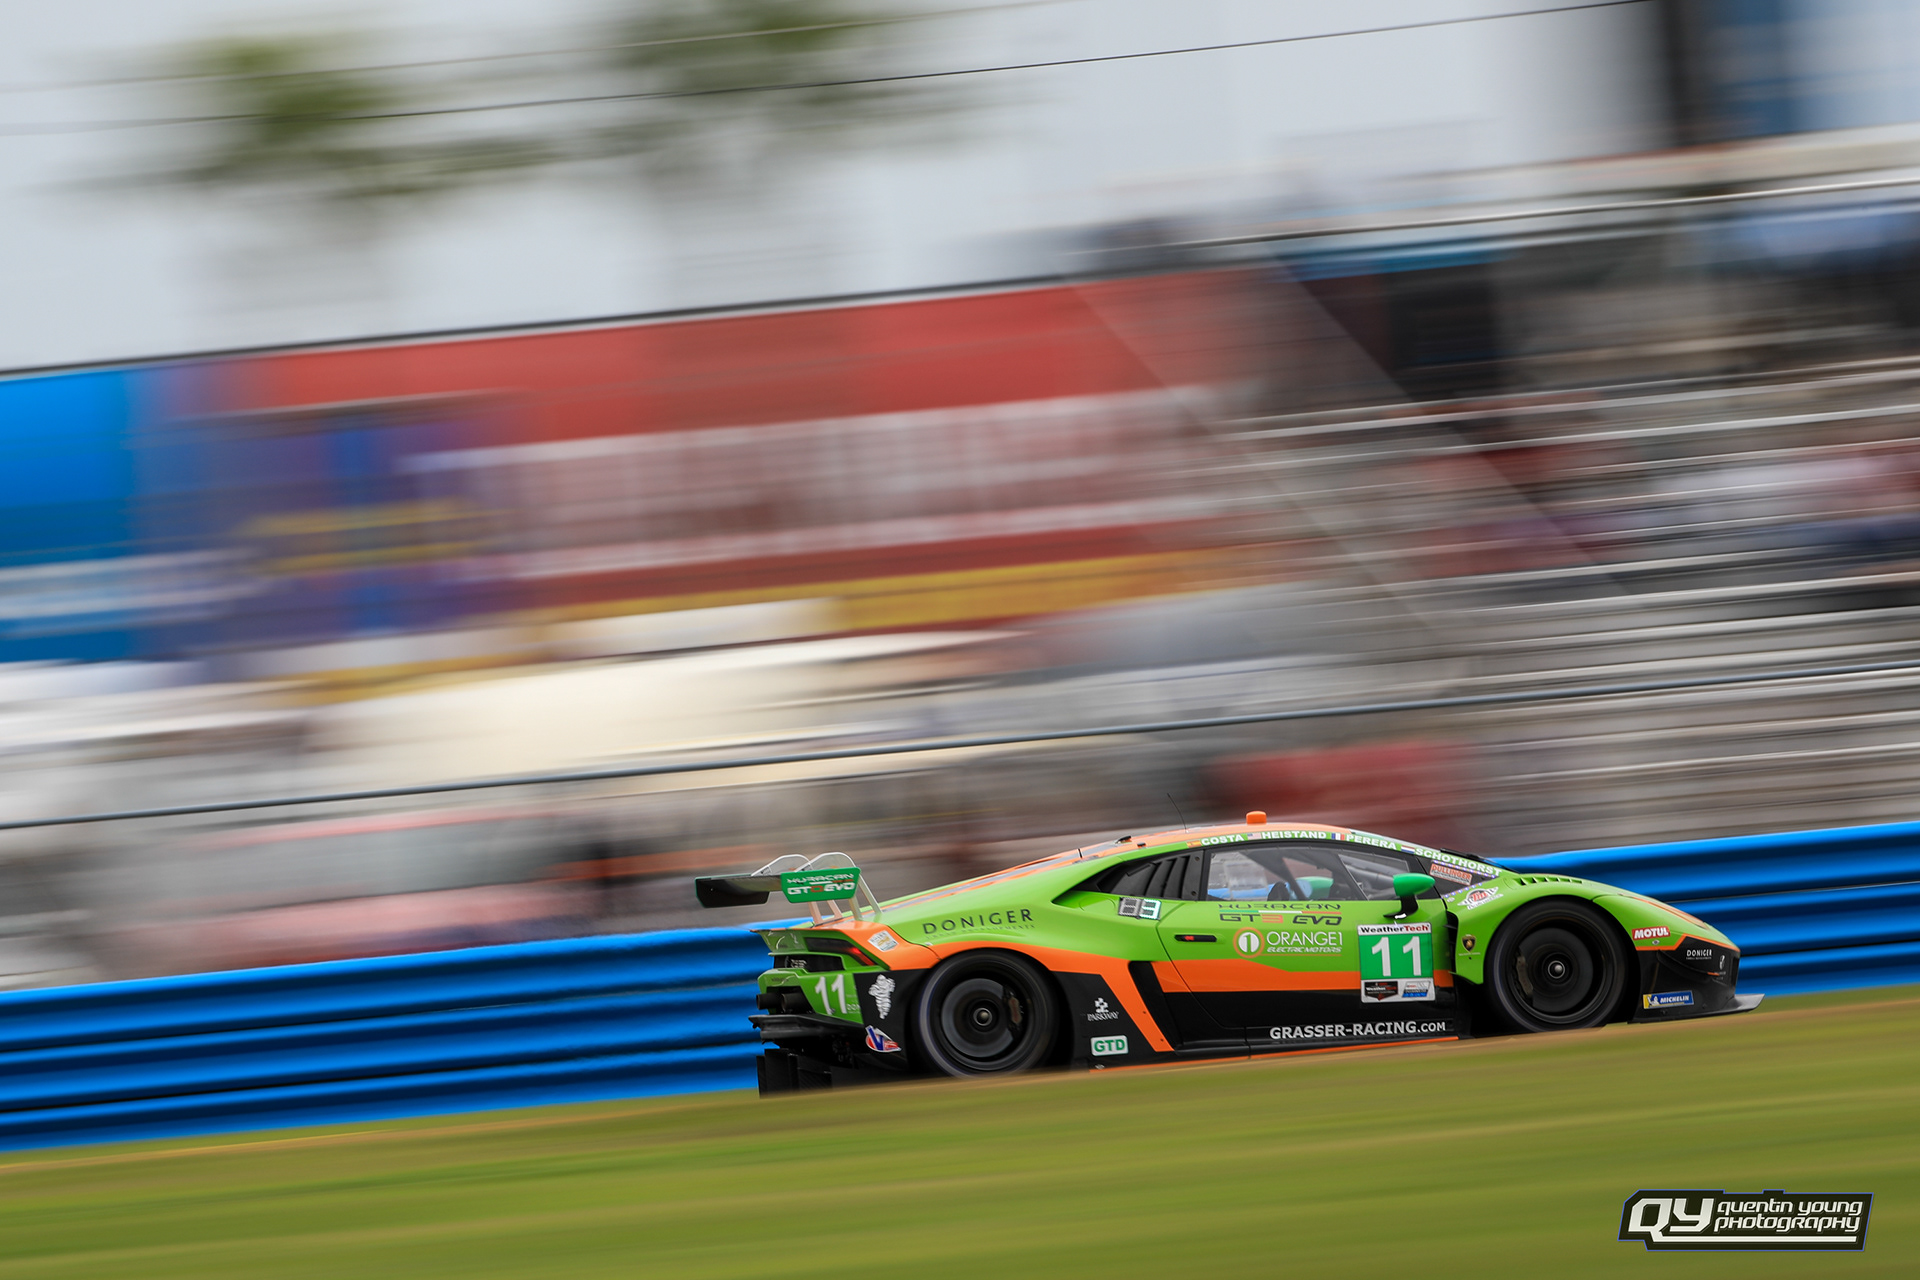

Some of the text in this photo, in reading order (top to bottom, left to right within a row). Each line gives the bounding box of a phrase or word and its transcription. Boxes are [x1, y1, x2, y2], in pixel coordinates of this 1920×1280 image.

[1201, 834, 1245, 847] COSTA
[1261, 831, 1327, 839] HEISTAND
[1346, 833, 1397, 851] PERERA
[1413, 847, 1503, 877] SCHOTHORST
[922, 908, 1034, 935] DONIGER
[1219, 913, 1343, 926] GT3 EVO
[1266, 931, 1343, 946] ORANGE1
[1634, 927, 1669, 939] MOTUL
[1371, 935, 1422, 977] 11
[814, 973, 848, 1015] 11
[1659, 995, 1690, 1004] MICHELIN
[1269, 1021, 1446, 1040] GRASSER-RACING.COM
[1094, 1039, 1125, 1052] GTD
